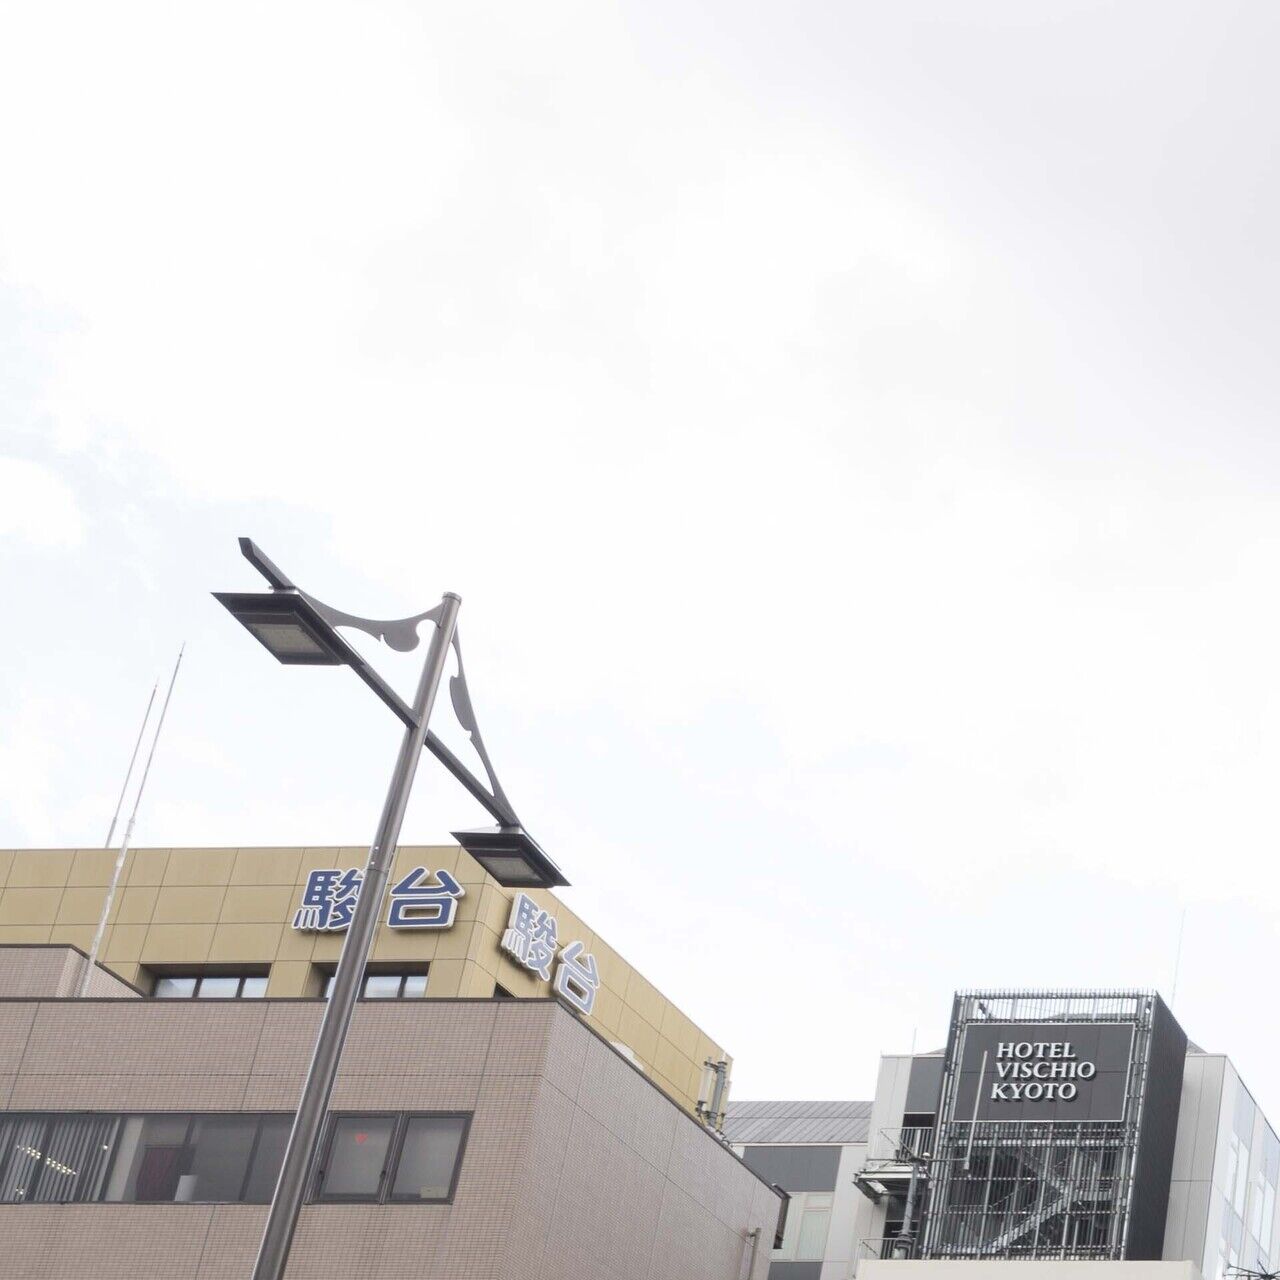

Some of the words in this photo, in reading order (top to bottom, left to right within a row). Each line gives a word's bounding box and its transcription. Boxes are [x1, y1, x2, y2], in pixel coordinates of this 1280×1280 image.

[291, 866, 466, 932] 駿台
[501, 892, 600, 1016] 駿台
[996, 1042, 1077, 1060] HOTEL
[996, 1061, 1097, 1080] VISCHIO
[990, 1082, 1078, 1101] KYOTO
